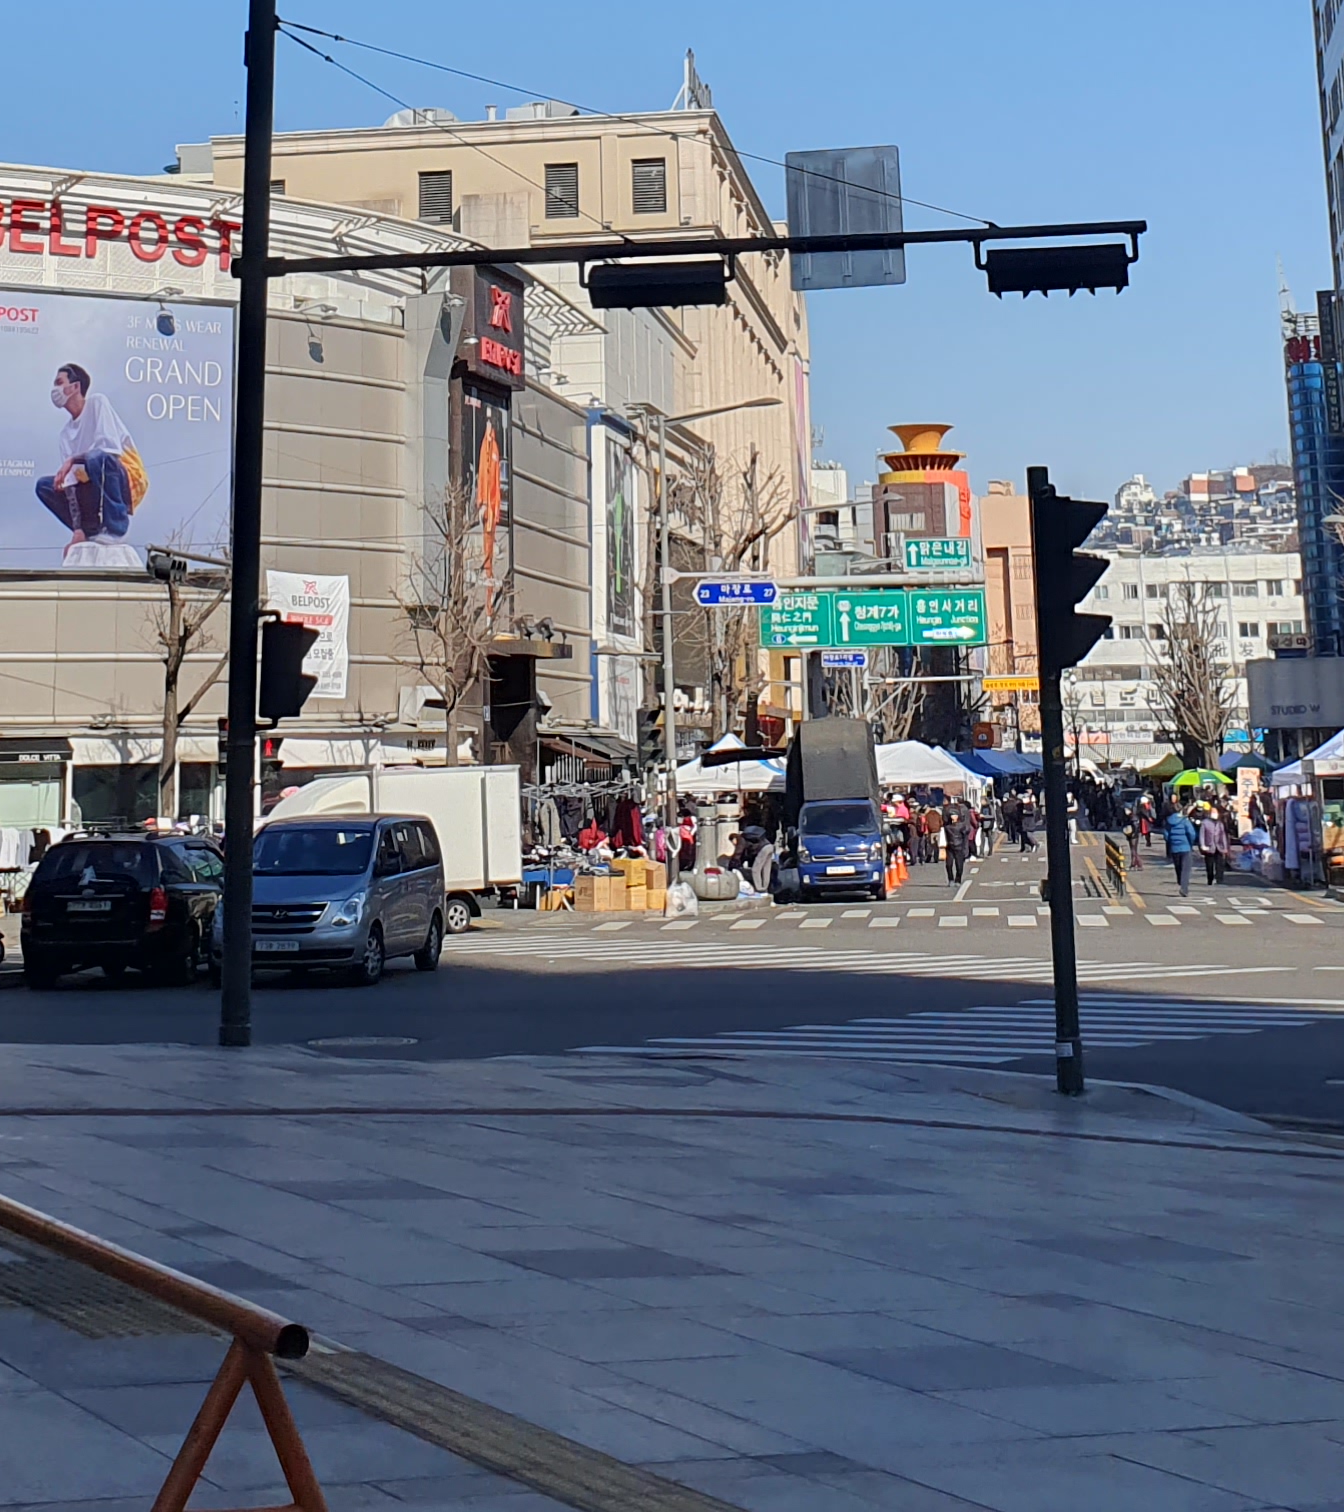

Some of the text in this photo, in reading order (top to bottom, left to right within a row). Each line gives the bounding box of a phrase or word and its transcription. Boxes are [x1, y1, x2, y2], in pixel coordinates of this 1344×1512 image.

[127, 315, 222, 335] 3F MS WEAR
[126, 335, 187, 352] RENEWAL
[125, 356, 223, 387] GRAND
[146, 393, 222, 422] OPEN
[919, 540, 967, 556] 맑은내길
[721, 584, 752, 595] 마장로
[763, 588, 774, 597] 27
[291, 595, 332, 608] BELPOST
[916, 598, 979, 614] 흥인사거리
[950, 614, 979, 625] Junction
[1271, 703, 1321, 716] STUDIO W
[18, 754, 40, 762] DOLCE
